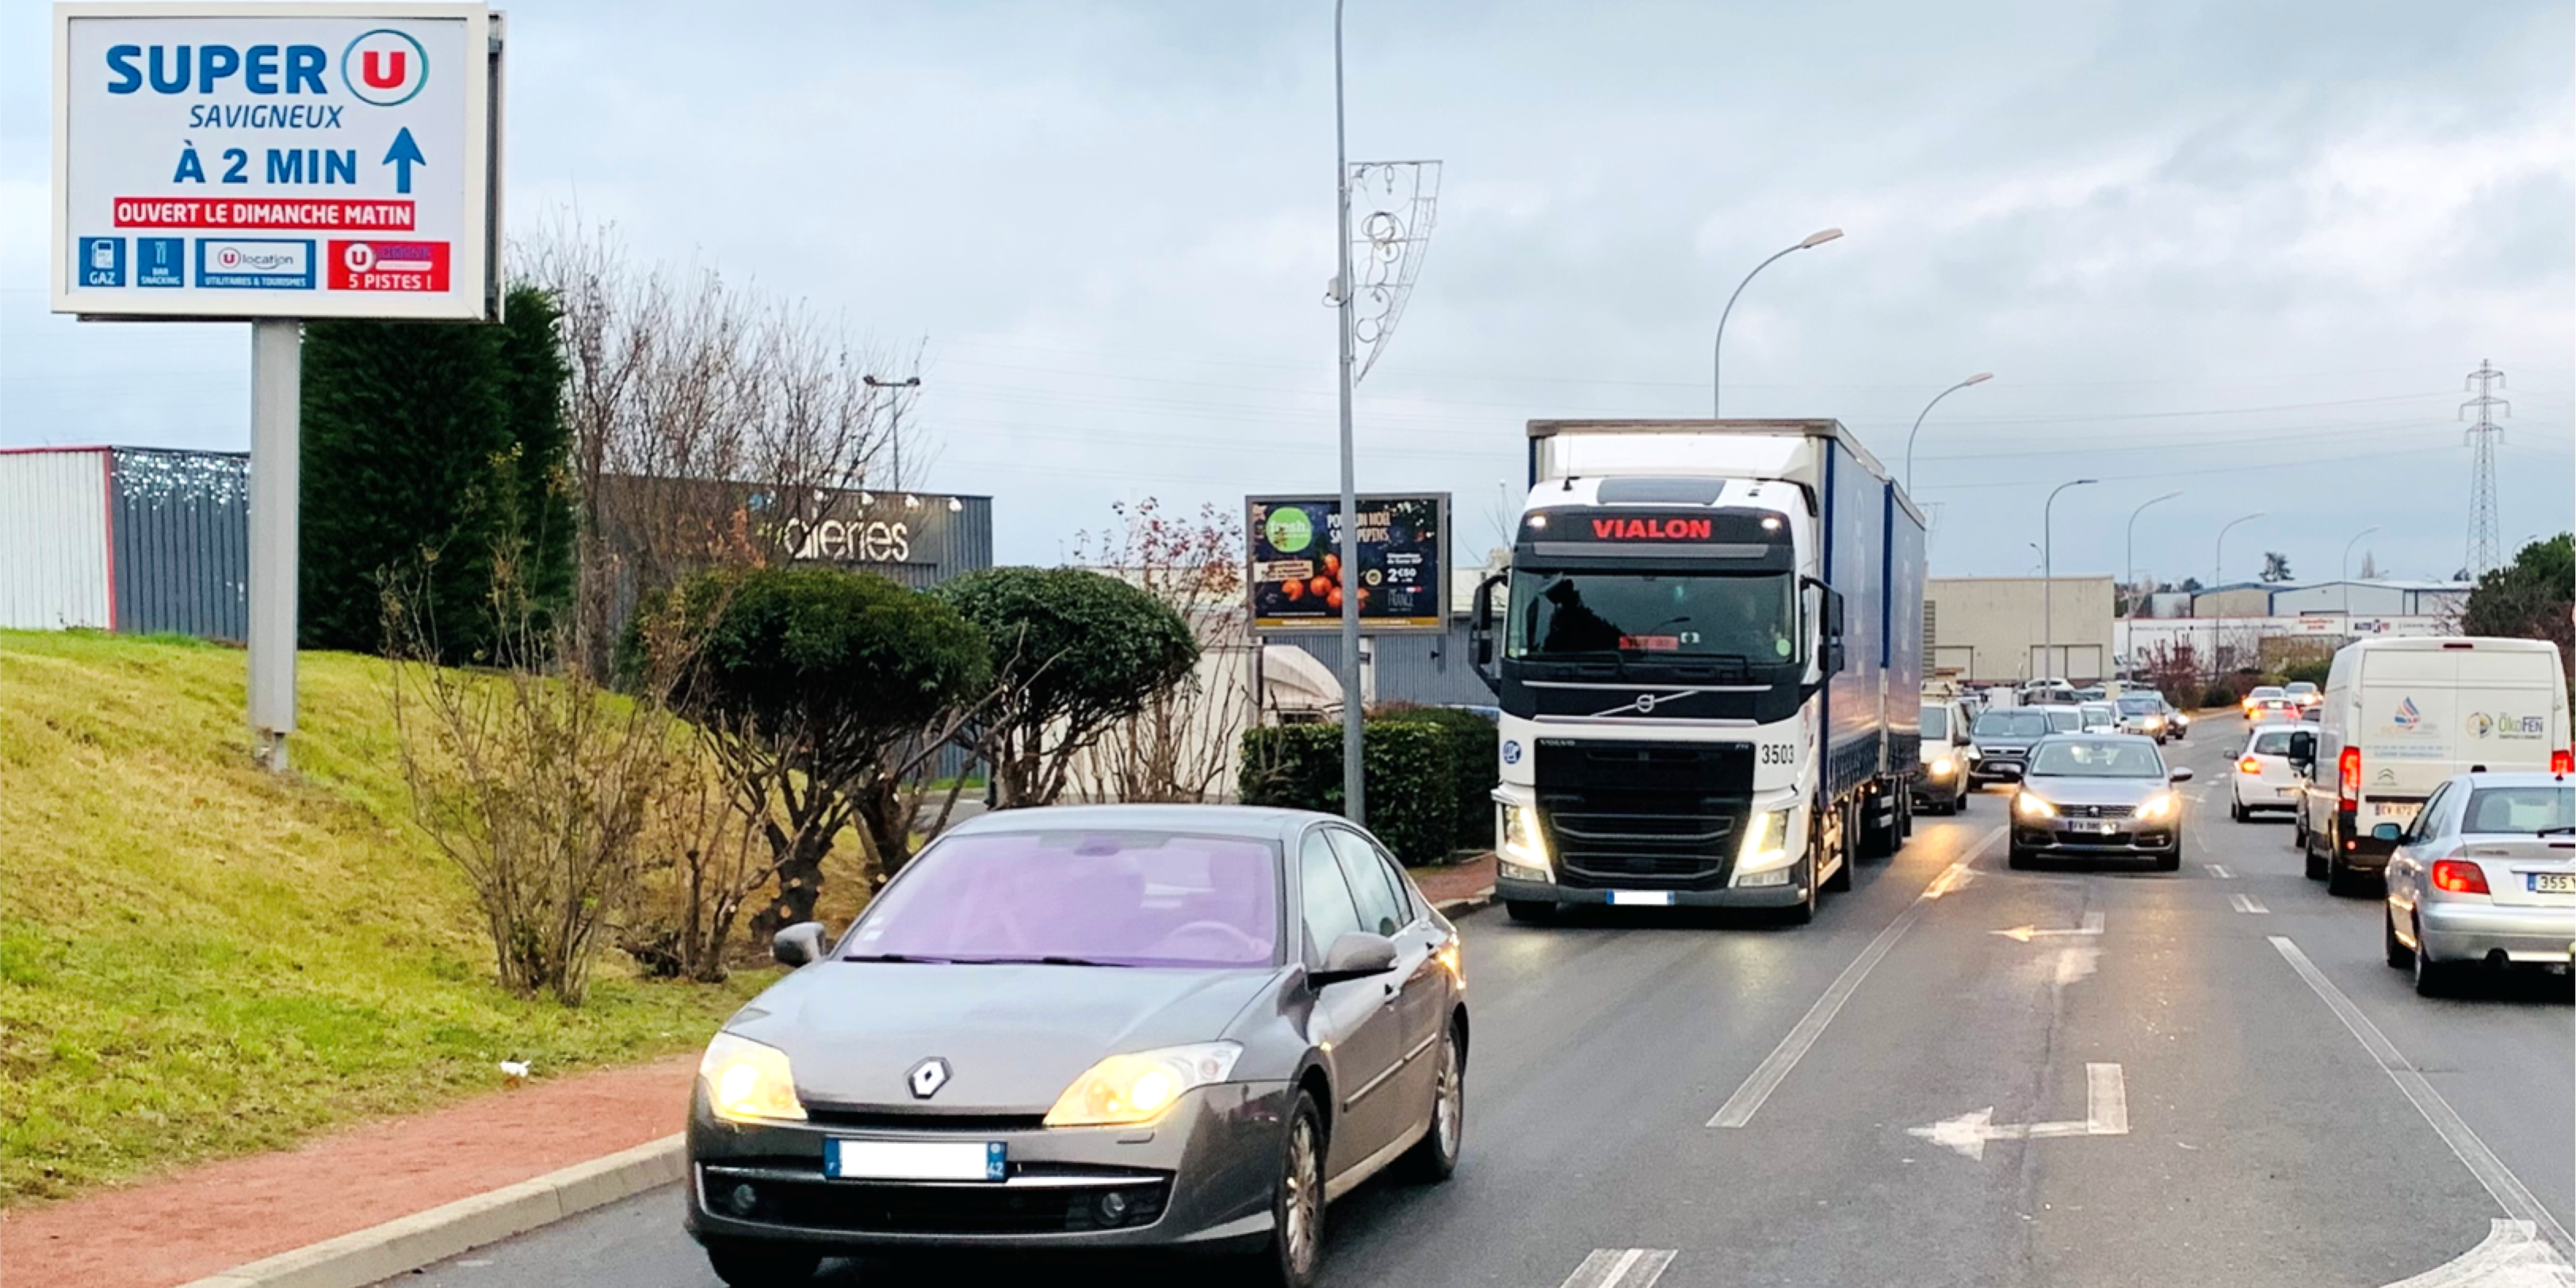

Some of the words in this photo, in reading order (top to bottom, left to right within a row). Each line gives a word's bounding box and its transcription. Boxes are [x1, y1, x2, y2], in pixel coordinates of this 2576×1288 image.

[106, 44, 327, 94] SUPER
[362, 51, 406, 90] U
[189, 104, 344, 129] SAVIGNEUX
[173, 140, 205, 184] À
[222, 148, 248, 184] 2
[267, 148, 357, 185] MIN
[117, 201, 201, 224] OUVERT
[204, 204, 229, 224] LE
[233, 204, 339, 225] DIMANCHE
[344, 206, 411, 227] MATIN
[224, 253, 235, 264] U
[243, 254, 294, 265] location
[352, 251, 367, 266] U
[89, 271, 116, 285] GAZ
[349, 273, 358, 289] 5
[365, 274, 422, 289] PISTES
[426, 275, 432, 289] !
[1592, 518, 1712, 540] VIALON
[1761, 743, 1795, 765] 3503
[989, 1161, 1005, 1175] 42
